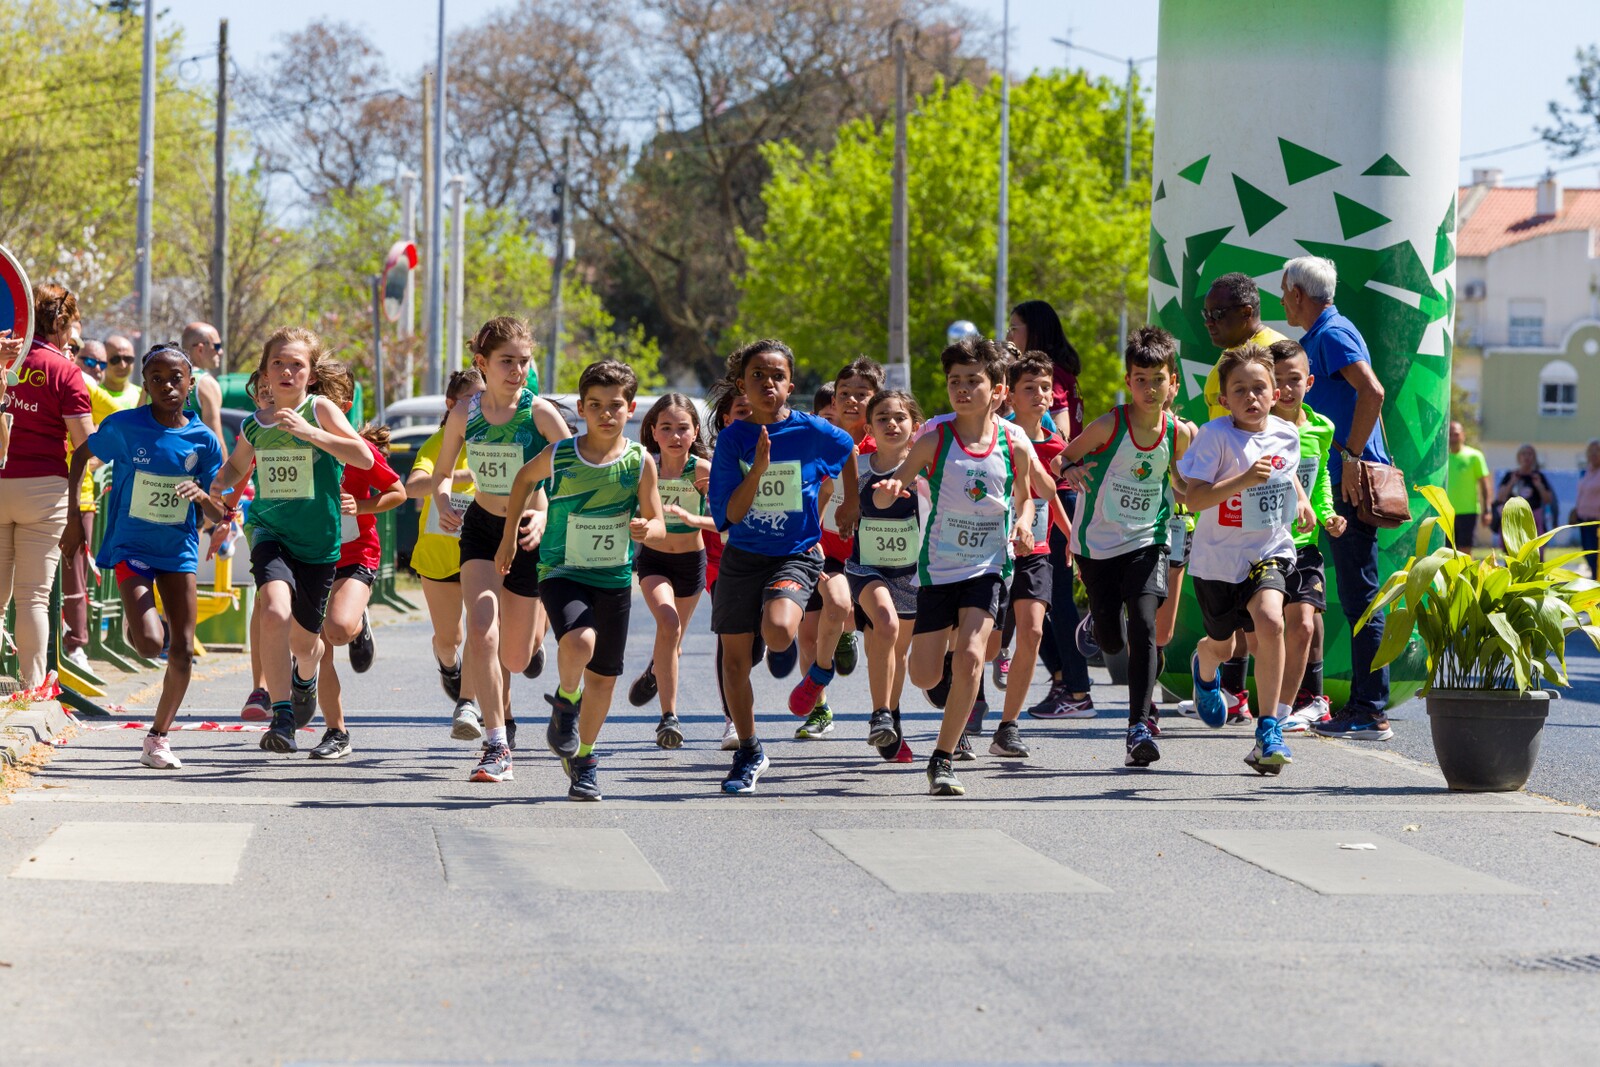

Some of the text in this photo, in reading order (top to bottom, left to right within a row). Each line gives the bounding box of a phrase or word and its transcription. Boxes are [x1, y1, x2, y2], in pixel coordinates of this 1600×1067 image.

[268, 466, 298, 482] 399
[478, 461, 507, 477] 451
[1296, 473, 1310, 488] 8
[148, 492, 179, 508] 236
[1120, 494, 1151, 511] 656
[1258, 493, 1285, 512] 632
[575, 522, 596, 530] ÉPOCA
[592, 534, 615, 550] 75
[875, 536, 907, 551] 349
[957, 530, 989, 547] 657
